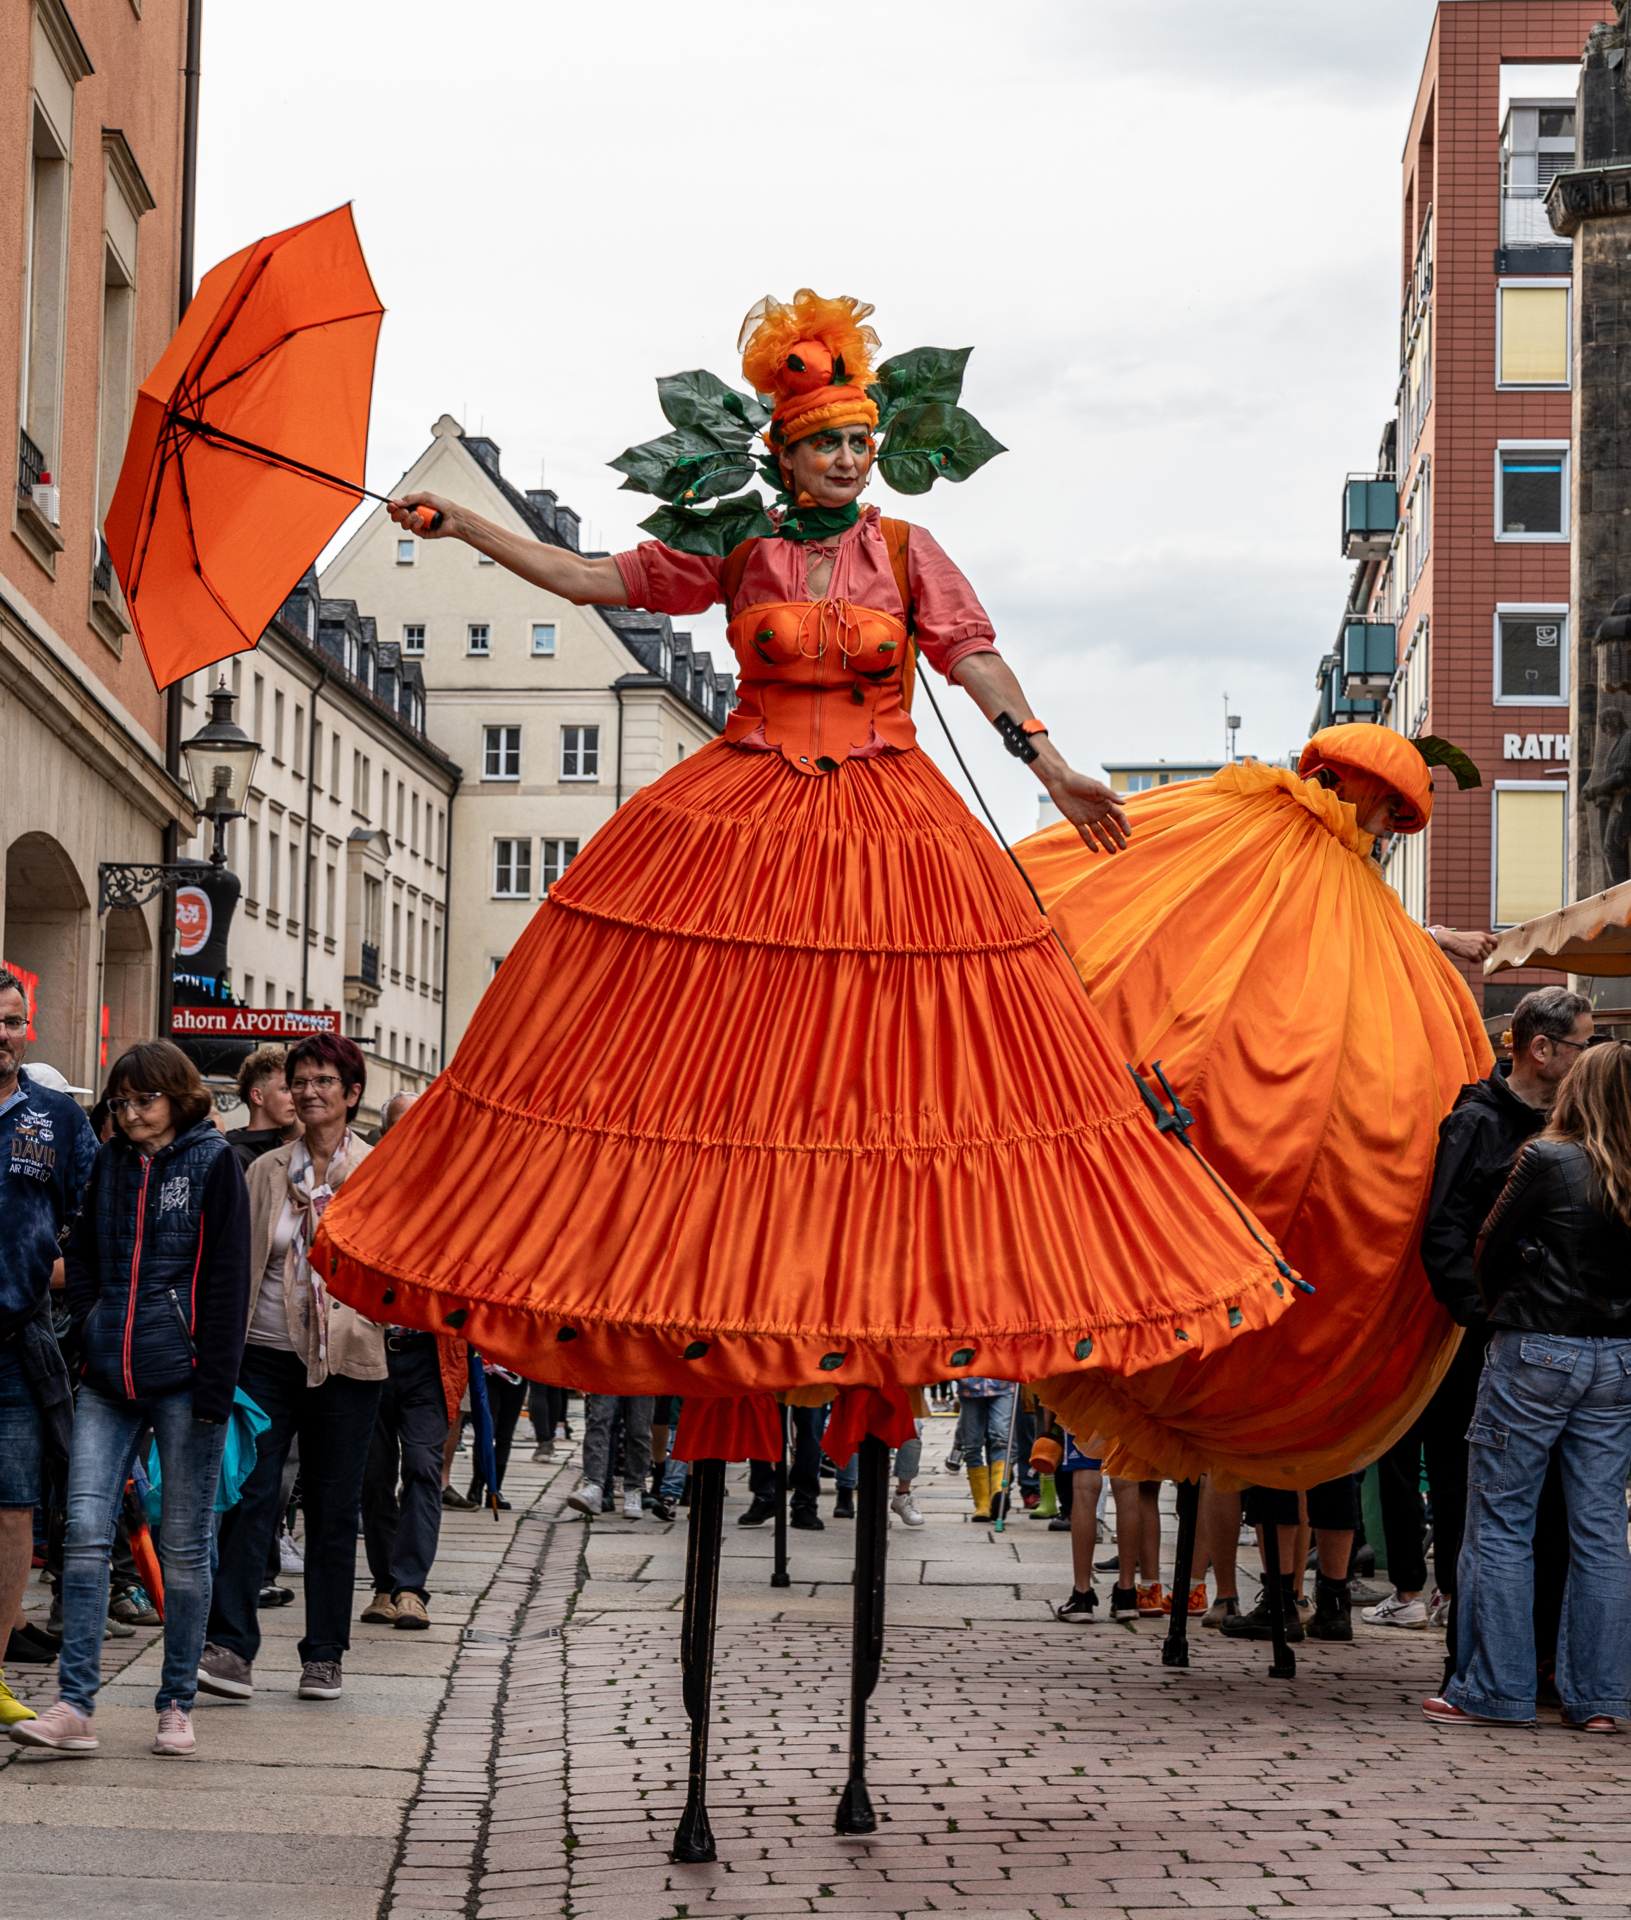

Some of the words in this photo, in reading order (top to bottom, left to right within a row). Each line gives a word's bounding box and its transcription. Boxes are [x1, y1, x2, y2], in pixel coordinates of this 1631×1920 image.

[172, 1010, 227, 1030] ahorn
[11, 1137, 56, 1169] DAVID
[9, 1163, 21, 1174] AIR
